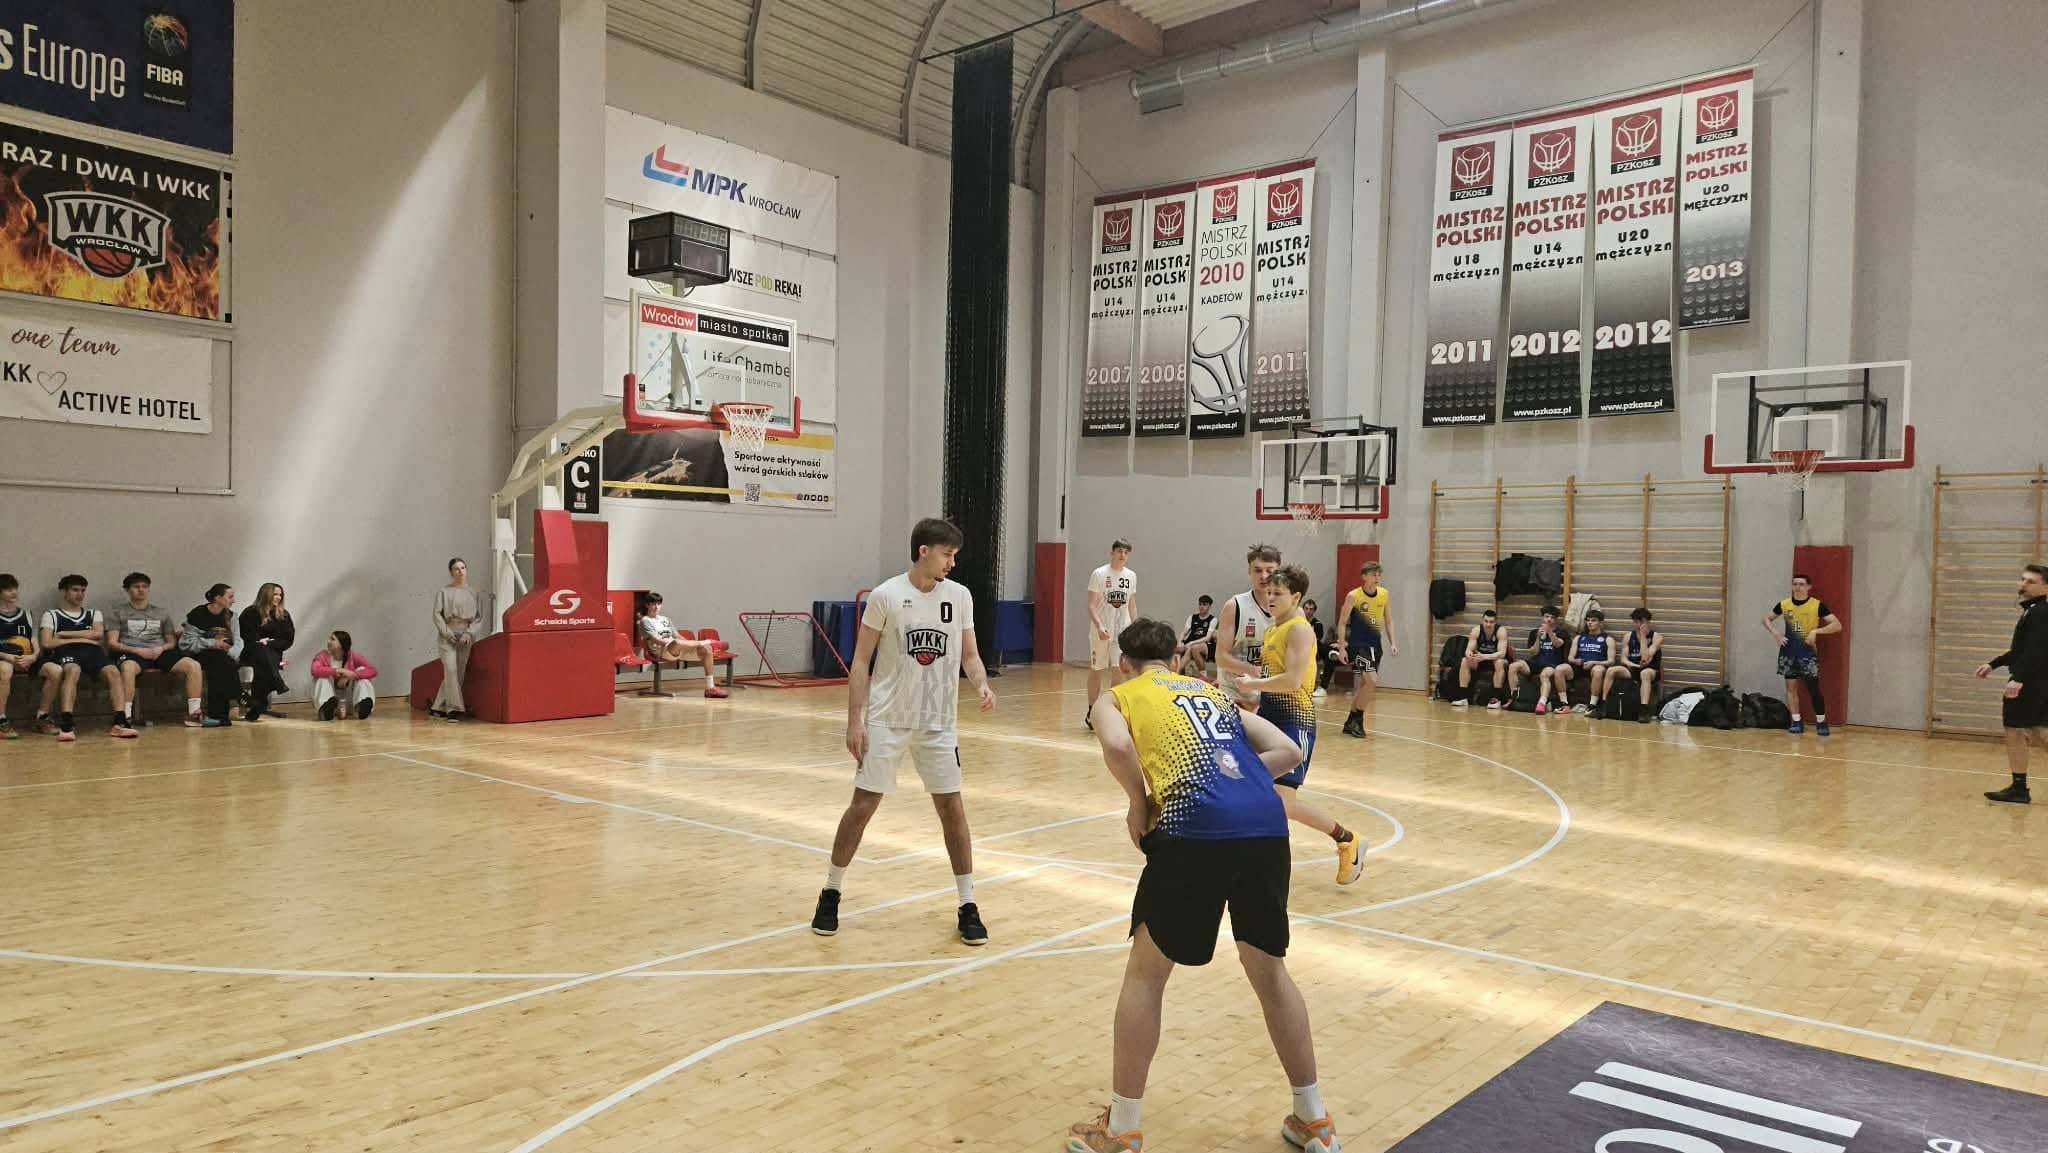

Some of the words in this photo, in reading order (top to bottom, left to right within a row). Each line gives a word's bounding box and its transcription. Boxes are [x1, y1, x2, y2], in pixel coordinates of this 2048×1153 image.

[23, 23, 125, 101] Europe
[146, 63, 183, 87] FIBA
[1686, 143, 1748, 165] MISTRZ
[2, 141, 53, 169] RAZ
[61, 153, 67, 172] I
[76, 158, 136, 186] DWA
[143, 171, 148, 188] I
[156, 174, 211, 201] WKK
[1686, 161, 1748, 183] POLSKI
[691, 168, 748, 203] MPK
[749, 196, 801, 220] WROCŁAW
[1597, 177, 1675, 205] MISTRZ
[1703, 184, 1729, 195] U20
[1514, 193, 1587, 218] MISTRZ
[1597, 197, 1673, 225] POLSKI
[1684, 193, 1748, 212] MĘŻCZYZN
[64, 202, 152, 249] WKK
[1436, 206, 1505, 230] MISTRZ
[1514, 213, 1585, 237] POLSKI
[75, 236, 141, 255] WROCŁAW
[1200, 224, 1248, 246] MISTRZ
[1436, 225, 1503, 248] POLSKI
[1618, 228, 1649, 243] U20
[1200, 241, 1247, 262] POLSKI
[1534, 242, 1562, 255] U14
[1596, 242, 1672, 261] mężczyzn
[1258, 252, 1306, 272] POLSK
[1453, 254, 1480, 266] U18
[1512, 255, 1583, 272] mężczyzn
[1094, 275, 1136, 291] POLSK
[1145, 270, 1189, 287] POLSK
[1199, 261, 1245, 286] 2010
[1272, 276, 1294, 288] U14
[1686, 261, 1744, 283] 2013
[755, 274, 773, 290] POD
[774, 279, 801, 298] RĘKA!
[1257, 289, 1307, 302] mężczyz
[1105, 297, 1122, 307] U14
[1156, 292, 1175, 303] U14
[1201, 291, 1243, 305] KADETÓW
[1092, 308, 1133, 318] mężczyz
[1143, 304, 1187, 316] mężczyz
[643, 304, 694, 328] Wrocław
[699, 318, 738, 334] miasto
[742, 325, 784, 343] spotkań
[1595, 319, 1671, 350] 2012
[11, 328, 53, 349] one
[57, 326, 121, 356] team
[1431, 339, 1492, 365] 2011
[1510, 329, 1580, 358] 2012
[0, 361, 32, 384] KK
[1141, 364, 1184, 384] 2008
[1256, 352, 1309, 375] 201
[58, 390, 131, 415] ACTIVE
[138, 397, 201, 421] HOTEL
[734, 450, 776, 463] Sportowe
[777, 454, 821, 468] aktywności
[570, 460, 590, 489] C
[734, 463, 760, 474] wśród
[761, 467, 797, 477] górskich
[798, 469, 829, 480] szlaków
[1118, 577, 1130, 589] 33
[569, 618, 596, 626] Sports
[940, 601, 953, 624] 0
[911, 631, 943, 650] WKK
[1173, 695, 1233, 740] 12
